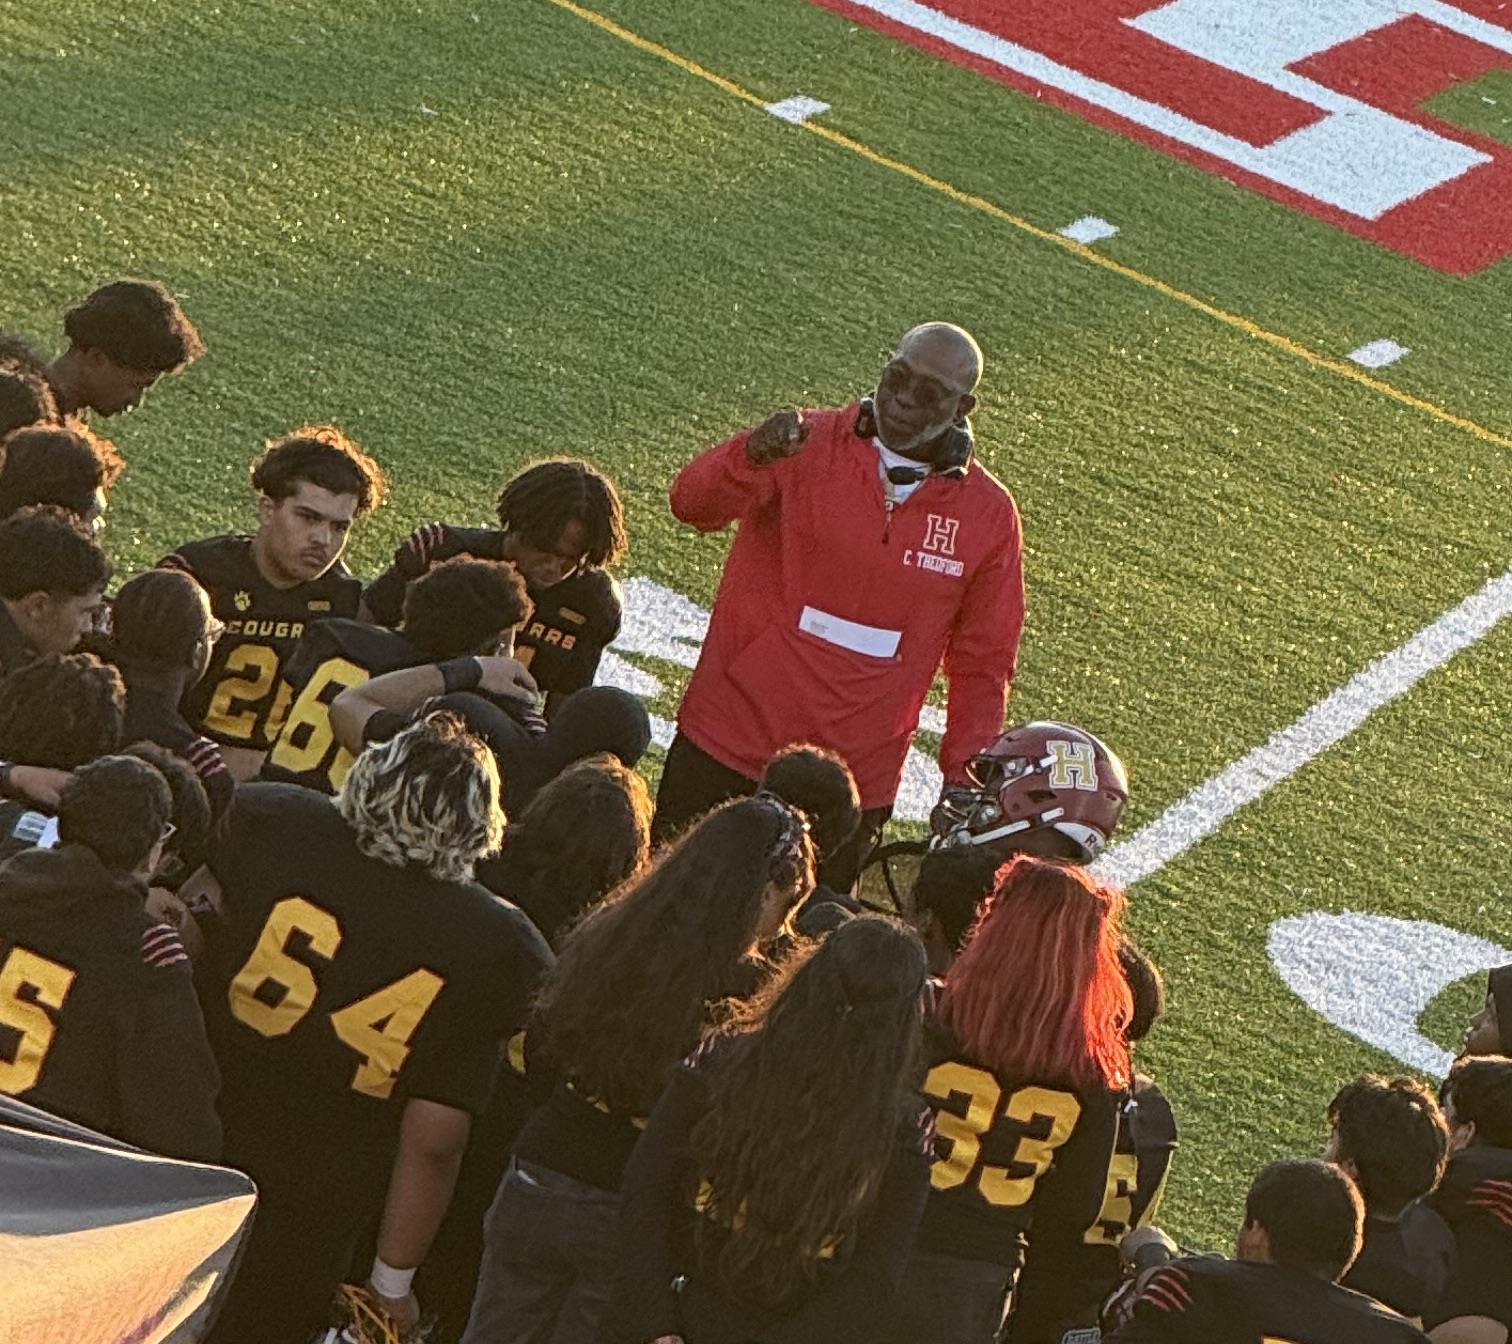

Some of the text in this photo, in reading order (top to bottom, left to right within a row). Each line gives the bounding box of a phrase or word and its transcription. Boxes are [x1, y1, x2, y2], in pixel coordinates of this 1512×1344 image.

[923, 513, 959, 556] H
[1045, 740, 1099, 792] H
[228, 895, 446, 1100] 64
[922, 1061, 1081, 1206] 33
